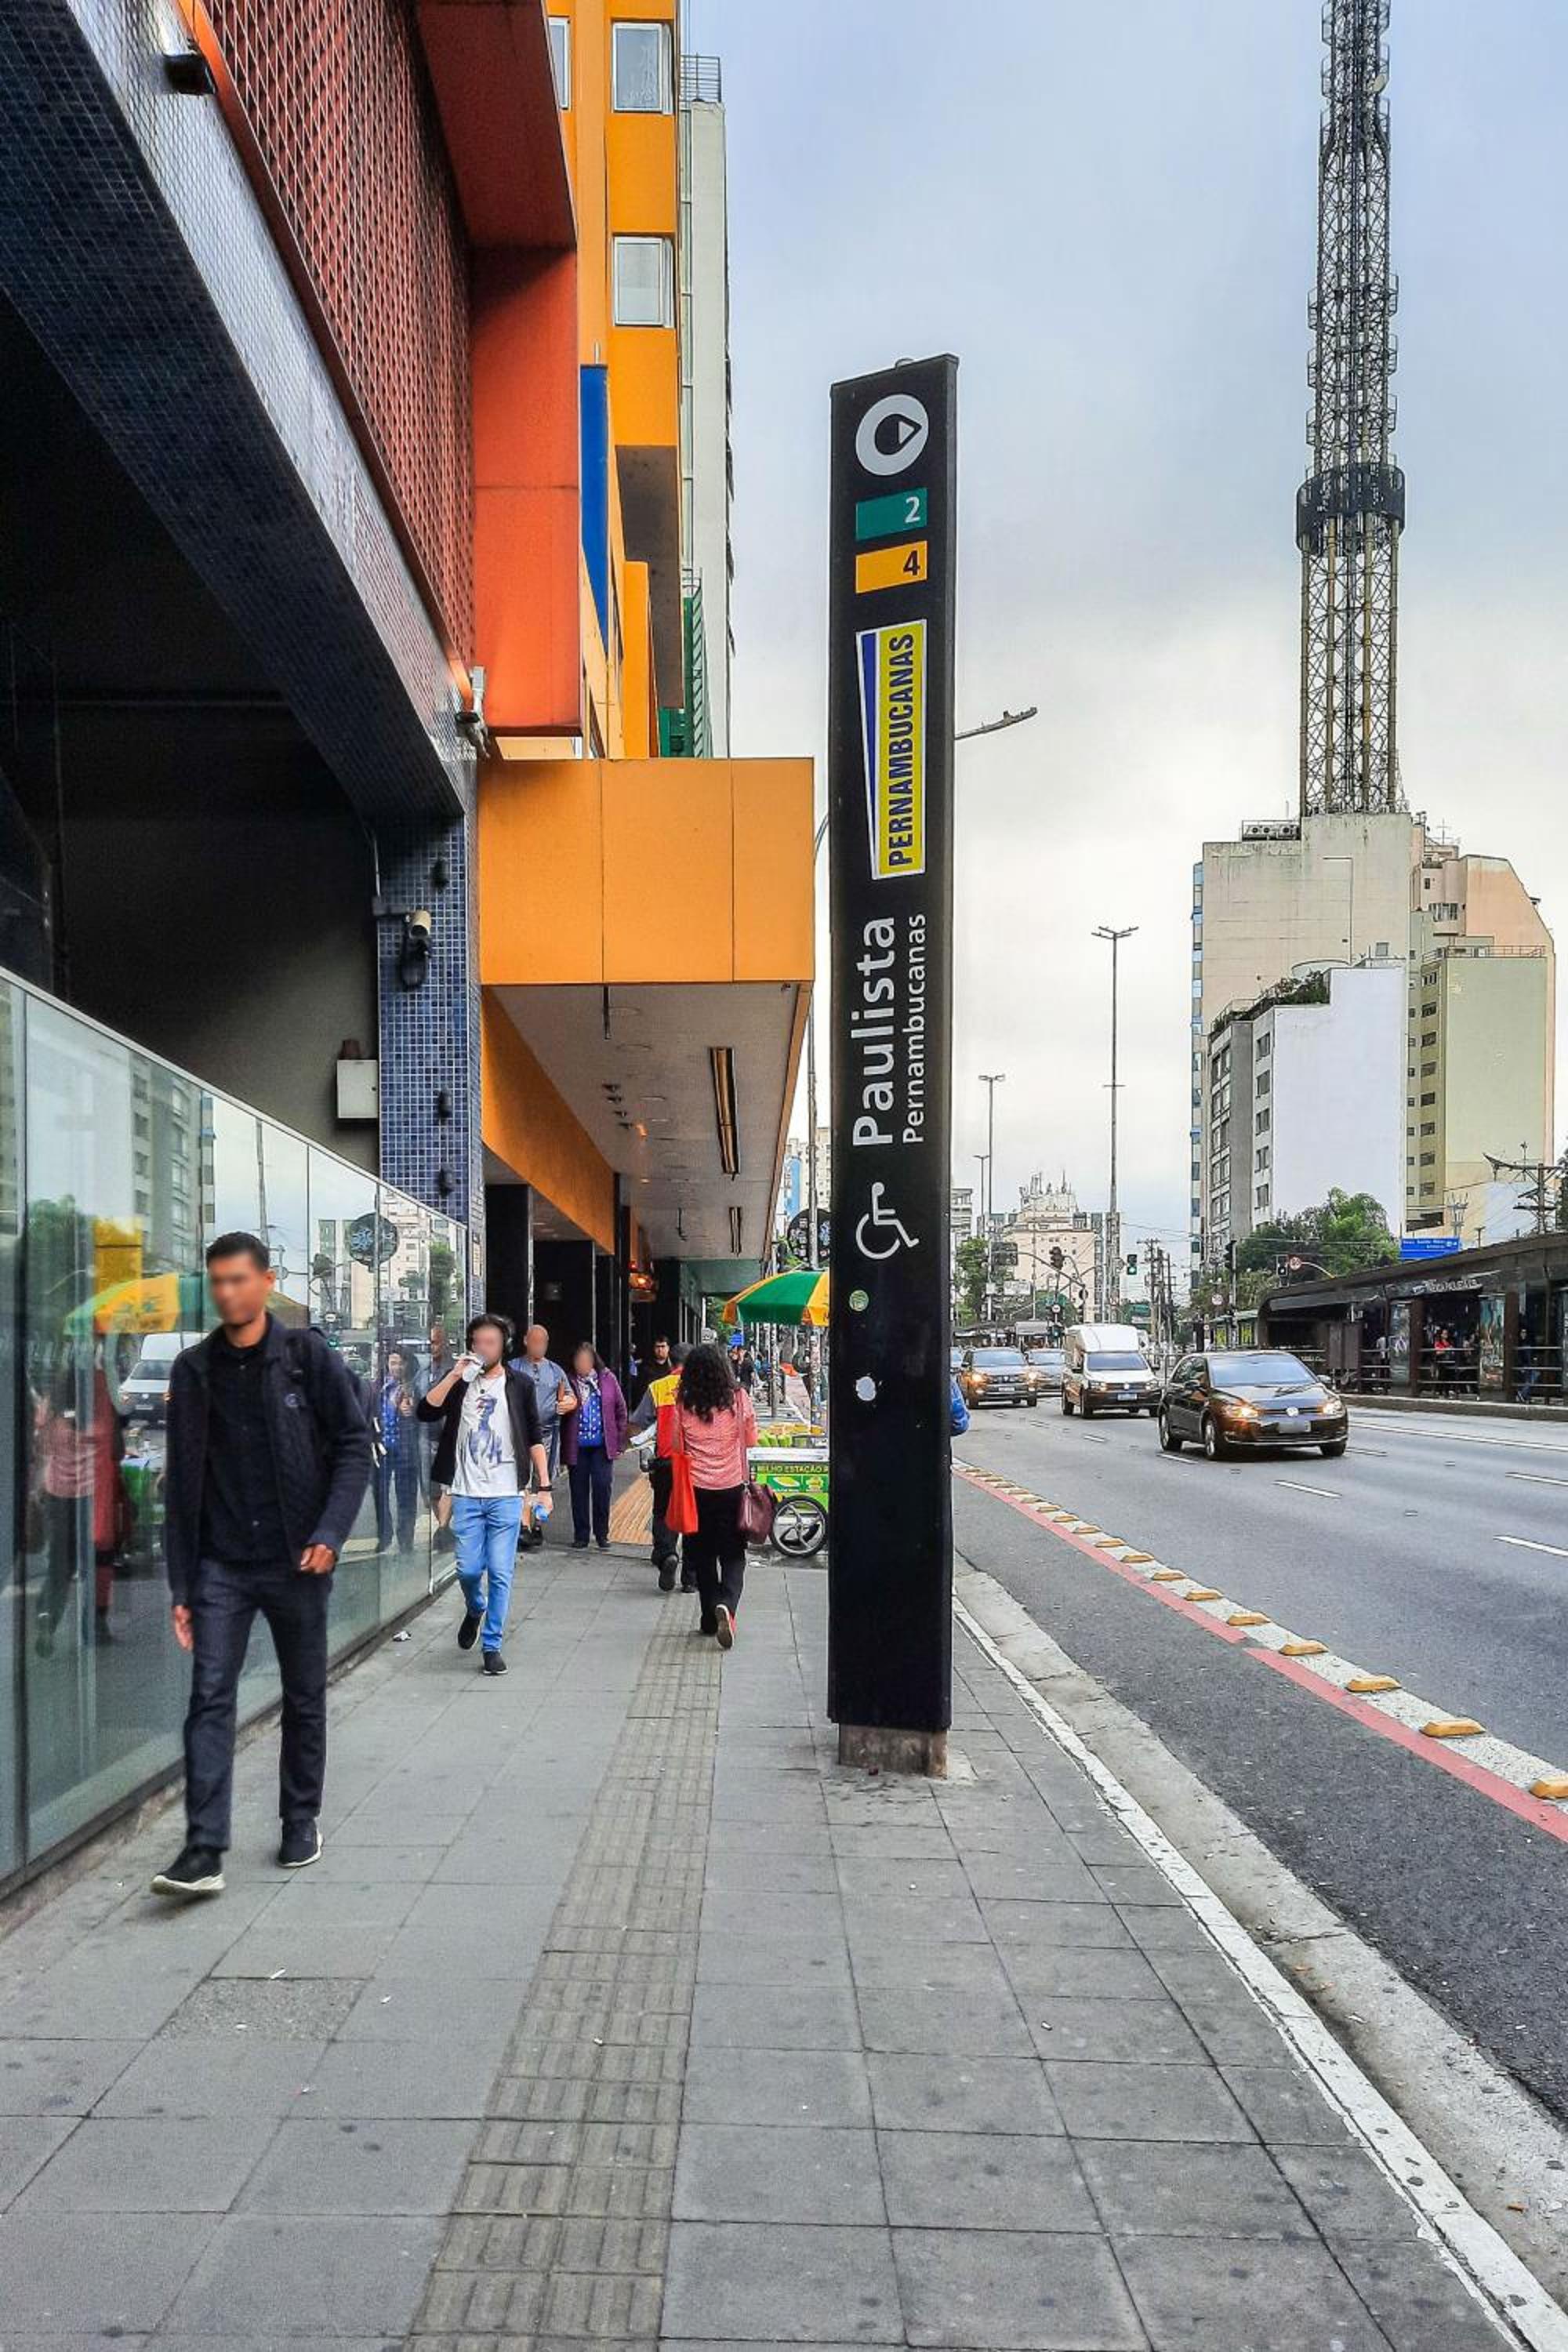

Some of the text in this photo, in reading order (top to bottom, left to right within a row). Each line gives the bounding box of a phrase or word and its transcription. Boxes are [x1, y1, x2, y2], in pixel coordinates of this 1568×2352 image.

[903, 550, 920, 575] 4
[906, 497, 920, 523] 2
[889, 634, 913, 866] PERNAMBUCANAS
[851, 918, 895, 1145] Paulista
[902, 914, 926, 1143] Pernambucanas
